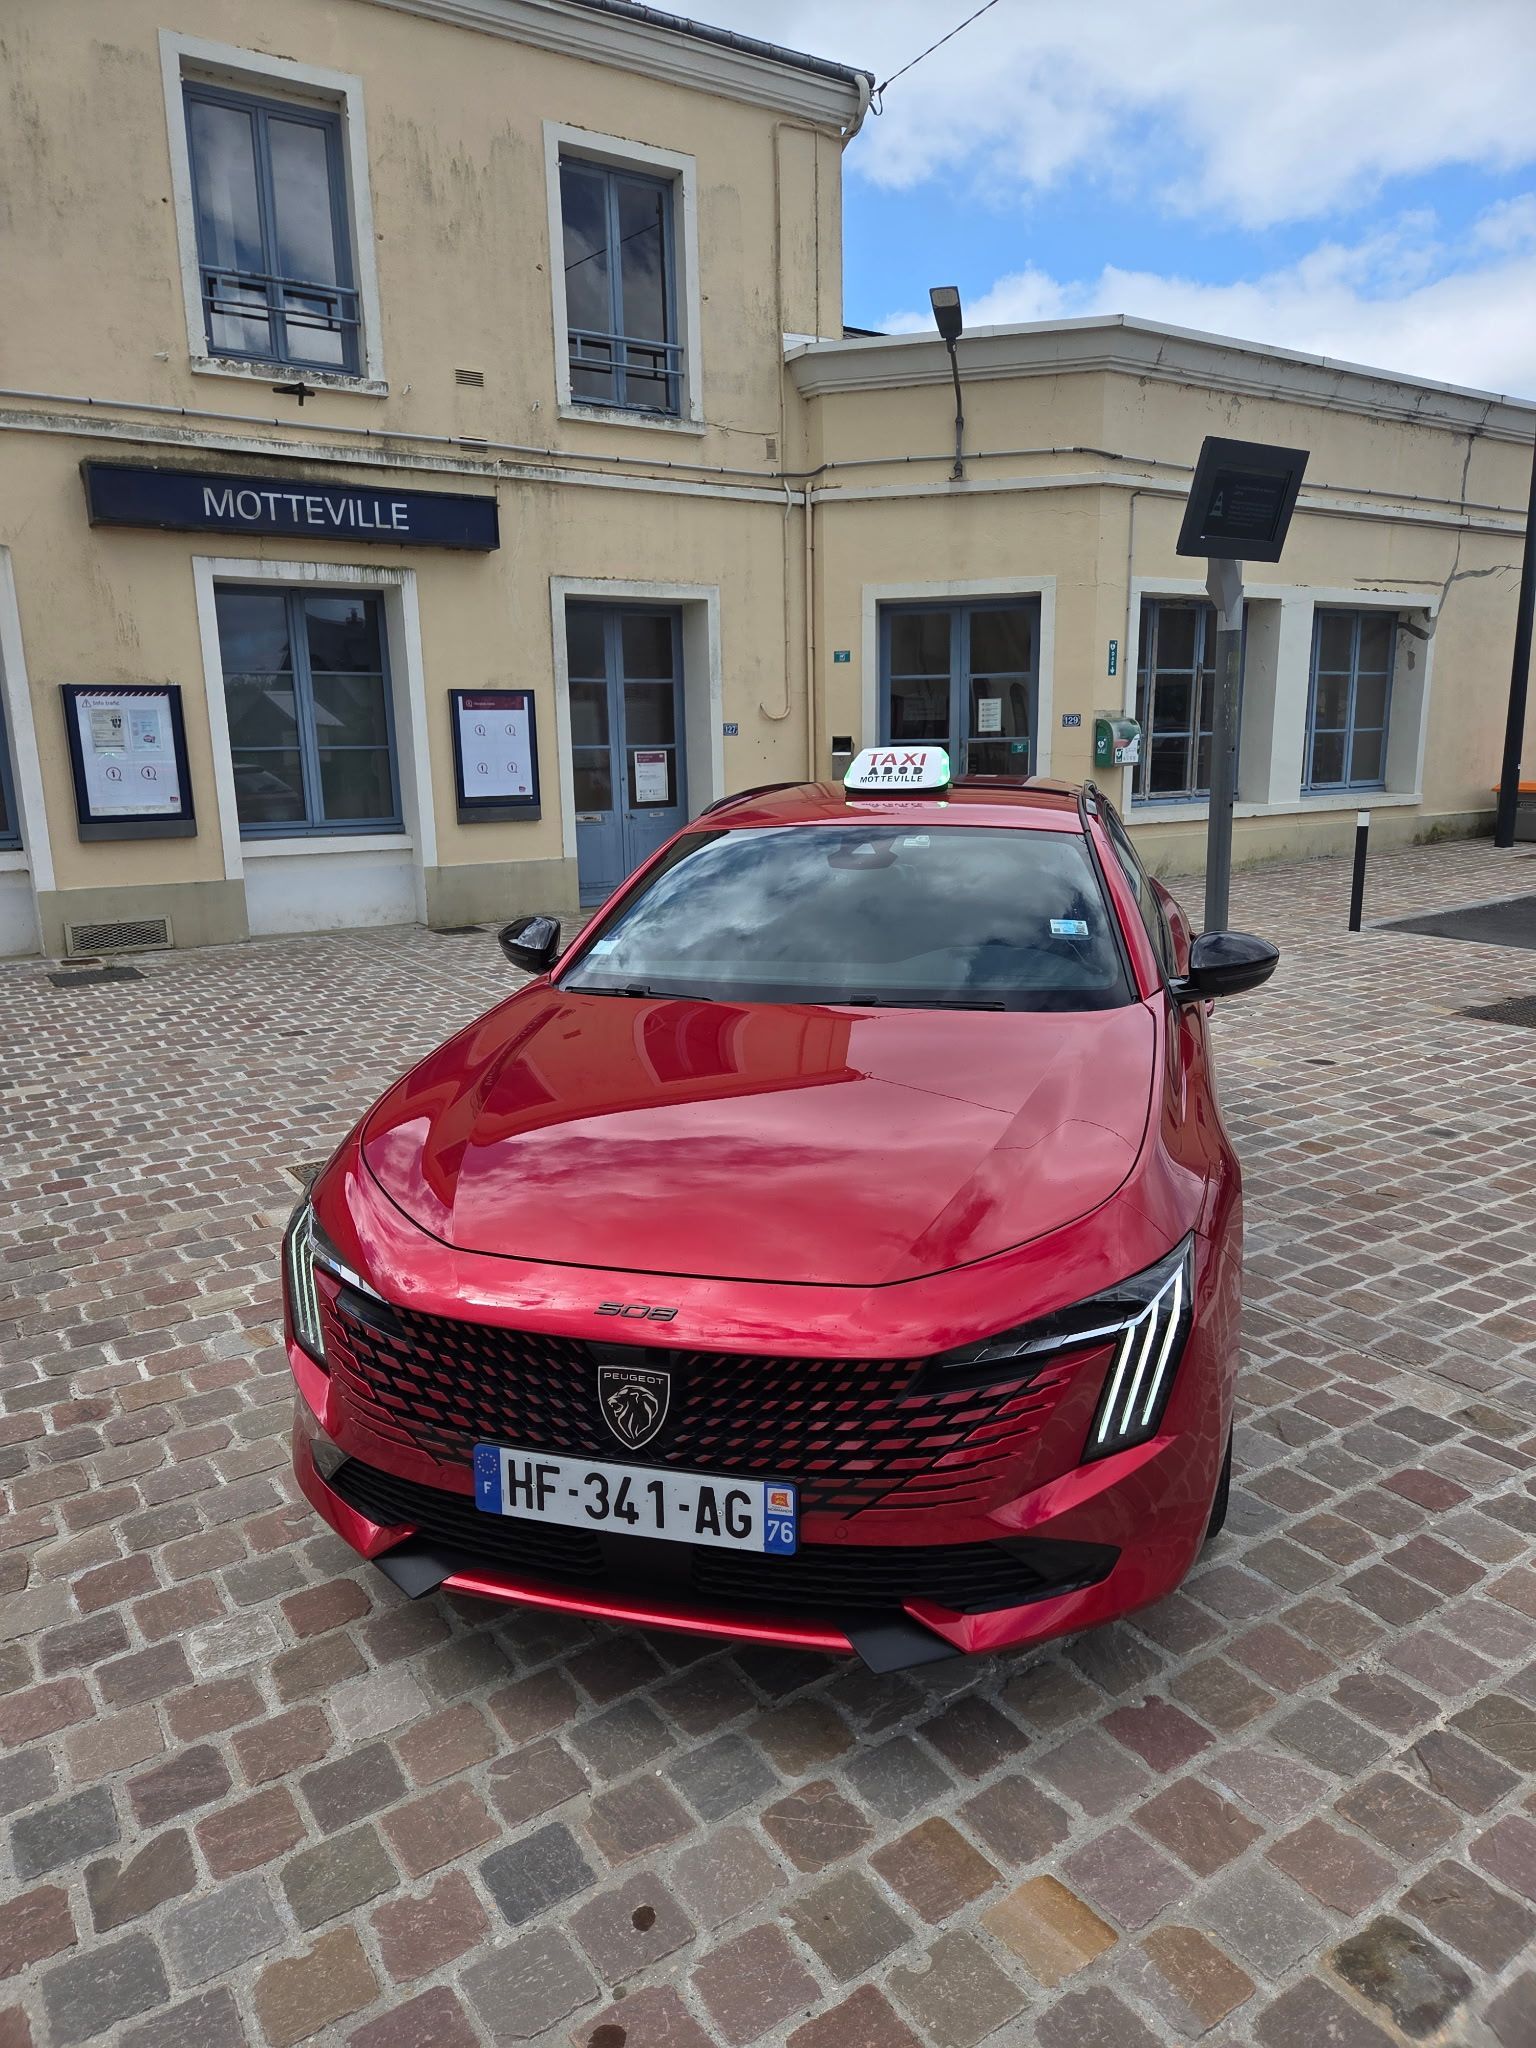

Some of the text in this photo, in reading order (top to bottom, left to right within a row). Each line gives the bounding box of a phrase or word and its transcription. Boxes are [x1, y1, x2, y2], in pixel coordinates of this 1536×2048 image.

[203, 487, 409, 531] MOTTEVILLE
[1064, 716, 1079, 725] 129
[725, 725, 736, 734] 127
[867, 752, 927, 767] TAXI
[860, 775, 923, 784] MOTTEVILLE
[594, 1301, 679, 1322] 508
[603, 1371, 664, 1386] PEUGEOT
[484, 1481, 491, 1494] F
[508, 1459, 752, 1539] HF-341-AG
[767, 1519, 794, 1544] 76
